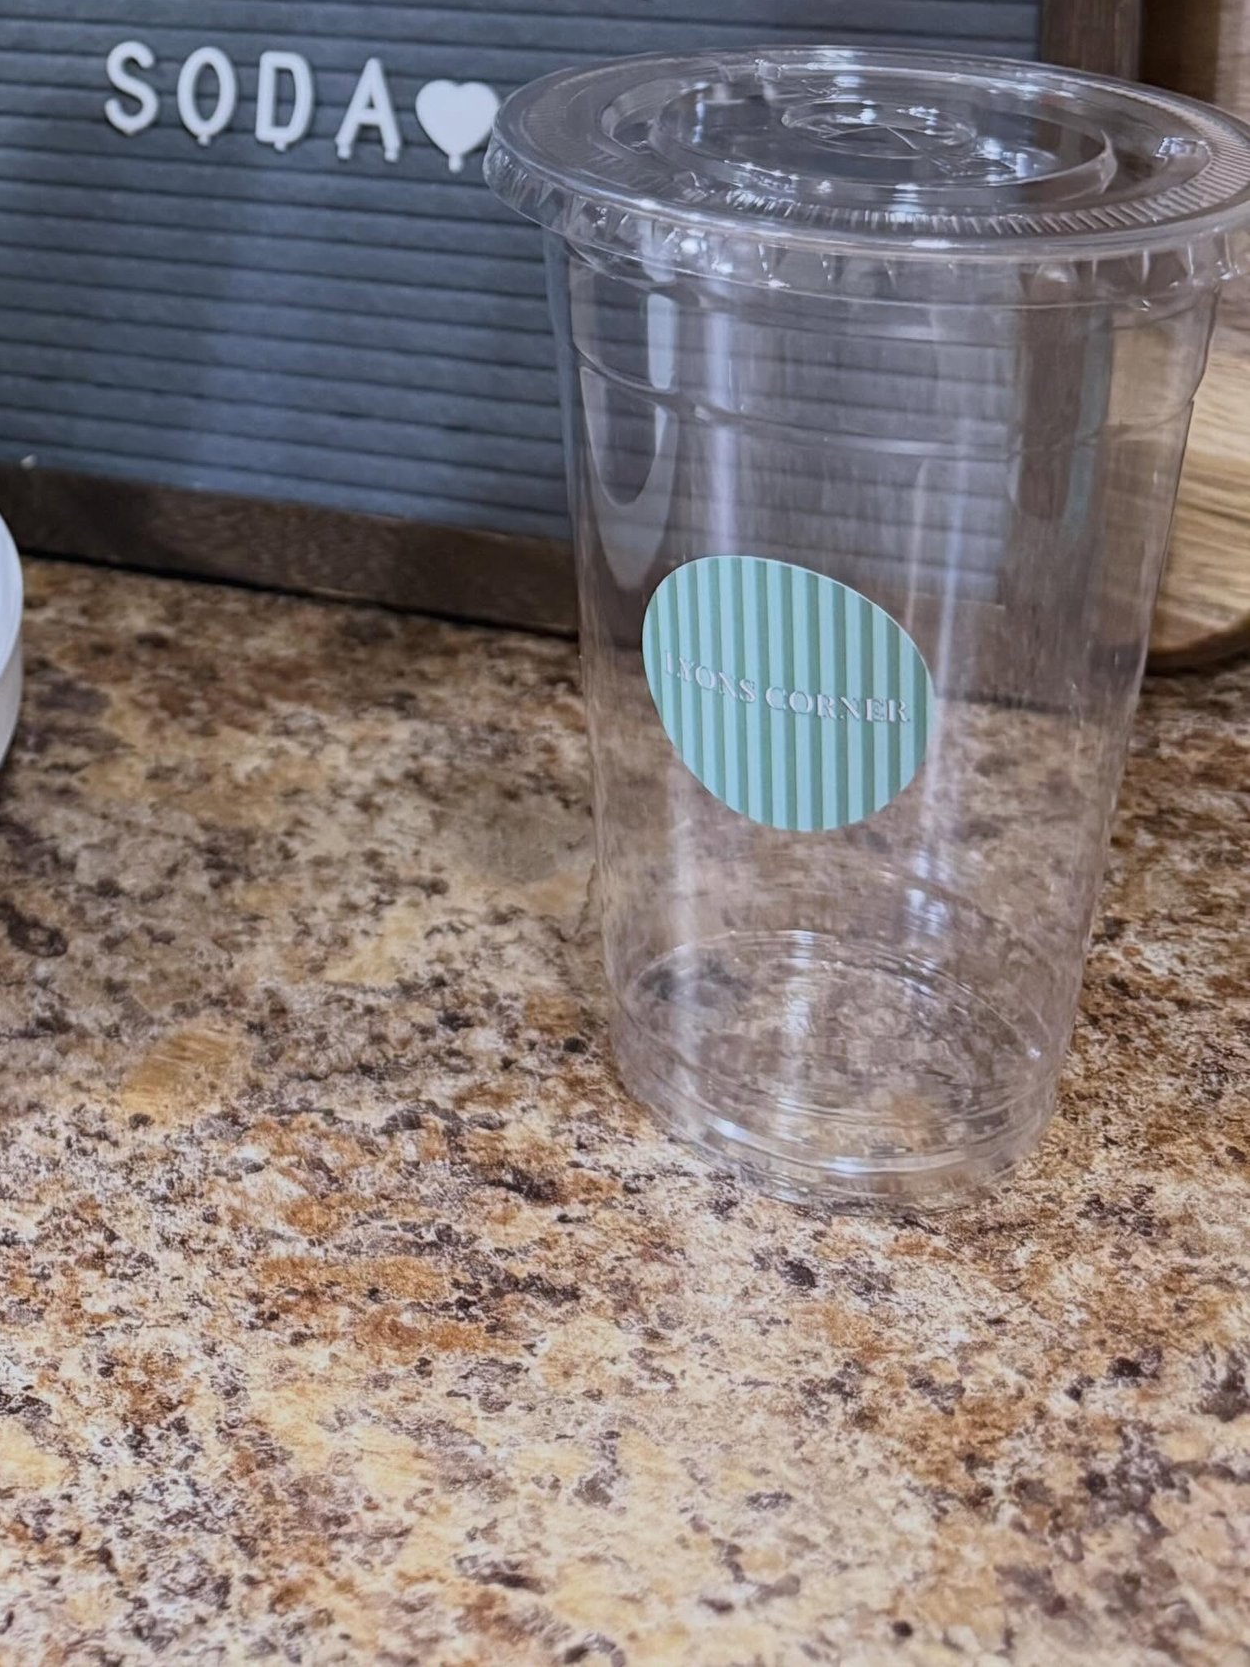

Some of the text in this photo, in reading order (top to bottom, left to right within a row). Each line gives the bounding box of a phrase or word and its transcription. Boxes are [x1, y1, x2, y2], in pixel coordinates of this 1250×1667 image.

[104, 41, 401, 163] SODA
[663, 649, 912, 724] LYONS CORNER
